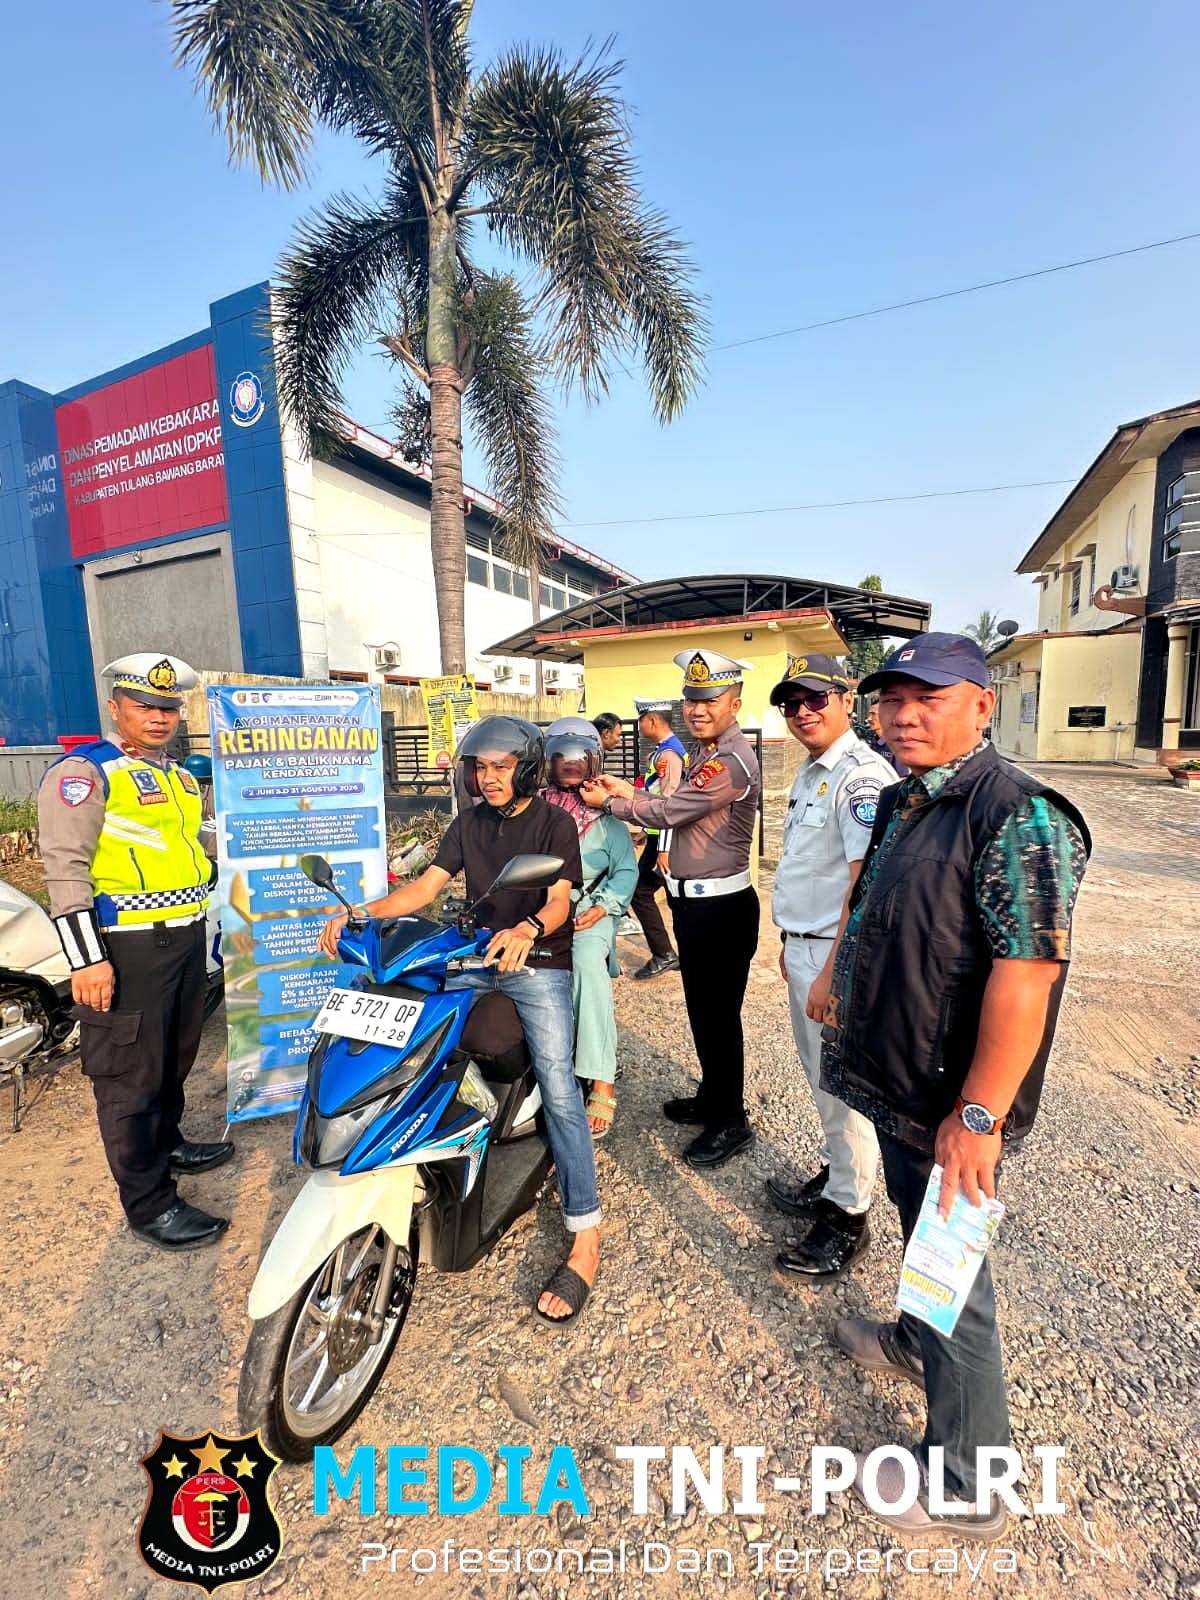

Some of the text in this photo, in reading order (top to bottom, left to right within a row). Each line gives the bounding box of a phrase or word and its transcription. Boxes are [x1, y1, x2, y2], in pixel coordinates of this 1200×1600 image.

[63, 442, 94, 465] DINAS
[94, 421, 150, 455] PEMADAM
[69, 467, 91, 488] DAN
[92, 439, 183, 480] PENYELAMATAN
[74, 484, 119, 504] KABUPATEN
[120, 473, 154, 492] TULANG
[155, 462, 194, 484] BAWANG
[233, 714, 360, 728] AYO! MANFAATKAN
[218, 726, 379, 756] KERINGANAN
[225, 756, 371, 770] PAJAK & BALIK NAMA
[263, 768, 339, 779] KENDARAAN
[301, 785, 338, 793] AGUSTUS
[262, 872, 306, 882] MUTASI/BA
[272, 880, 302, 889] DALAM
[263, 888, 296, 899] DISKON
[297, 887, 315, 896] PKB
[310, 894, 328, 902] 50%
[271, 920, 327, 932] MUTASI MASU
[262, 928, 323, 941] LAMPUNG DISK
[263, 936, 319, 950] TAHUN PERTA
[271, 948, 299, 956] TAHUN
[280, 969, 339, 982] DISKON PAJAK
[284, 978, 335, 988] KENDARAAN
[281, 990, 296, 998] 5%
[299, 988, 313, 996] s.d
[326, 993, 349, 1011] BE
[351, 997, 390, 1019] 5721
[280, 1028, 312, 1039] BEBAS
[364, 1024, 406, 1041] 11-28
[294, 1036, 317, 1046] & PA
[288, 1045, 313, 1056] PROG
[390, 1113, 428, 1153] HONDA
